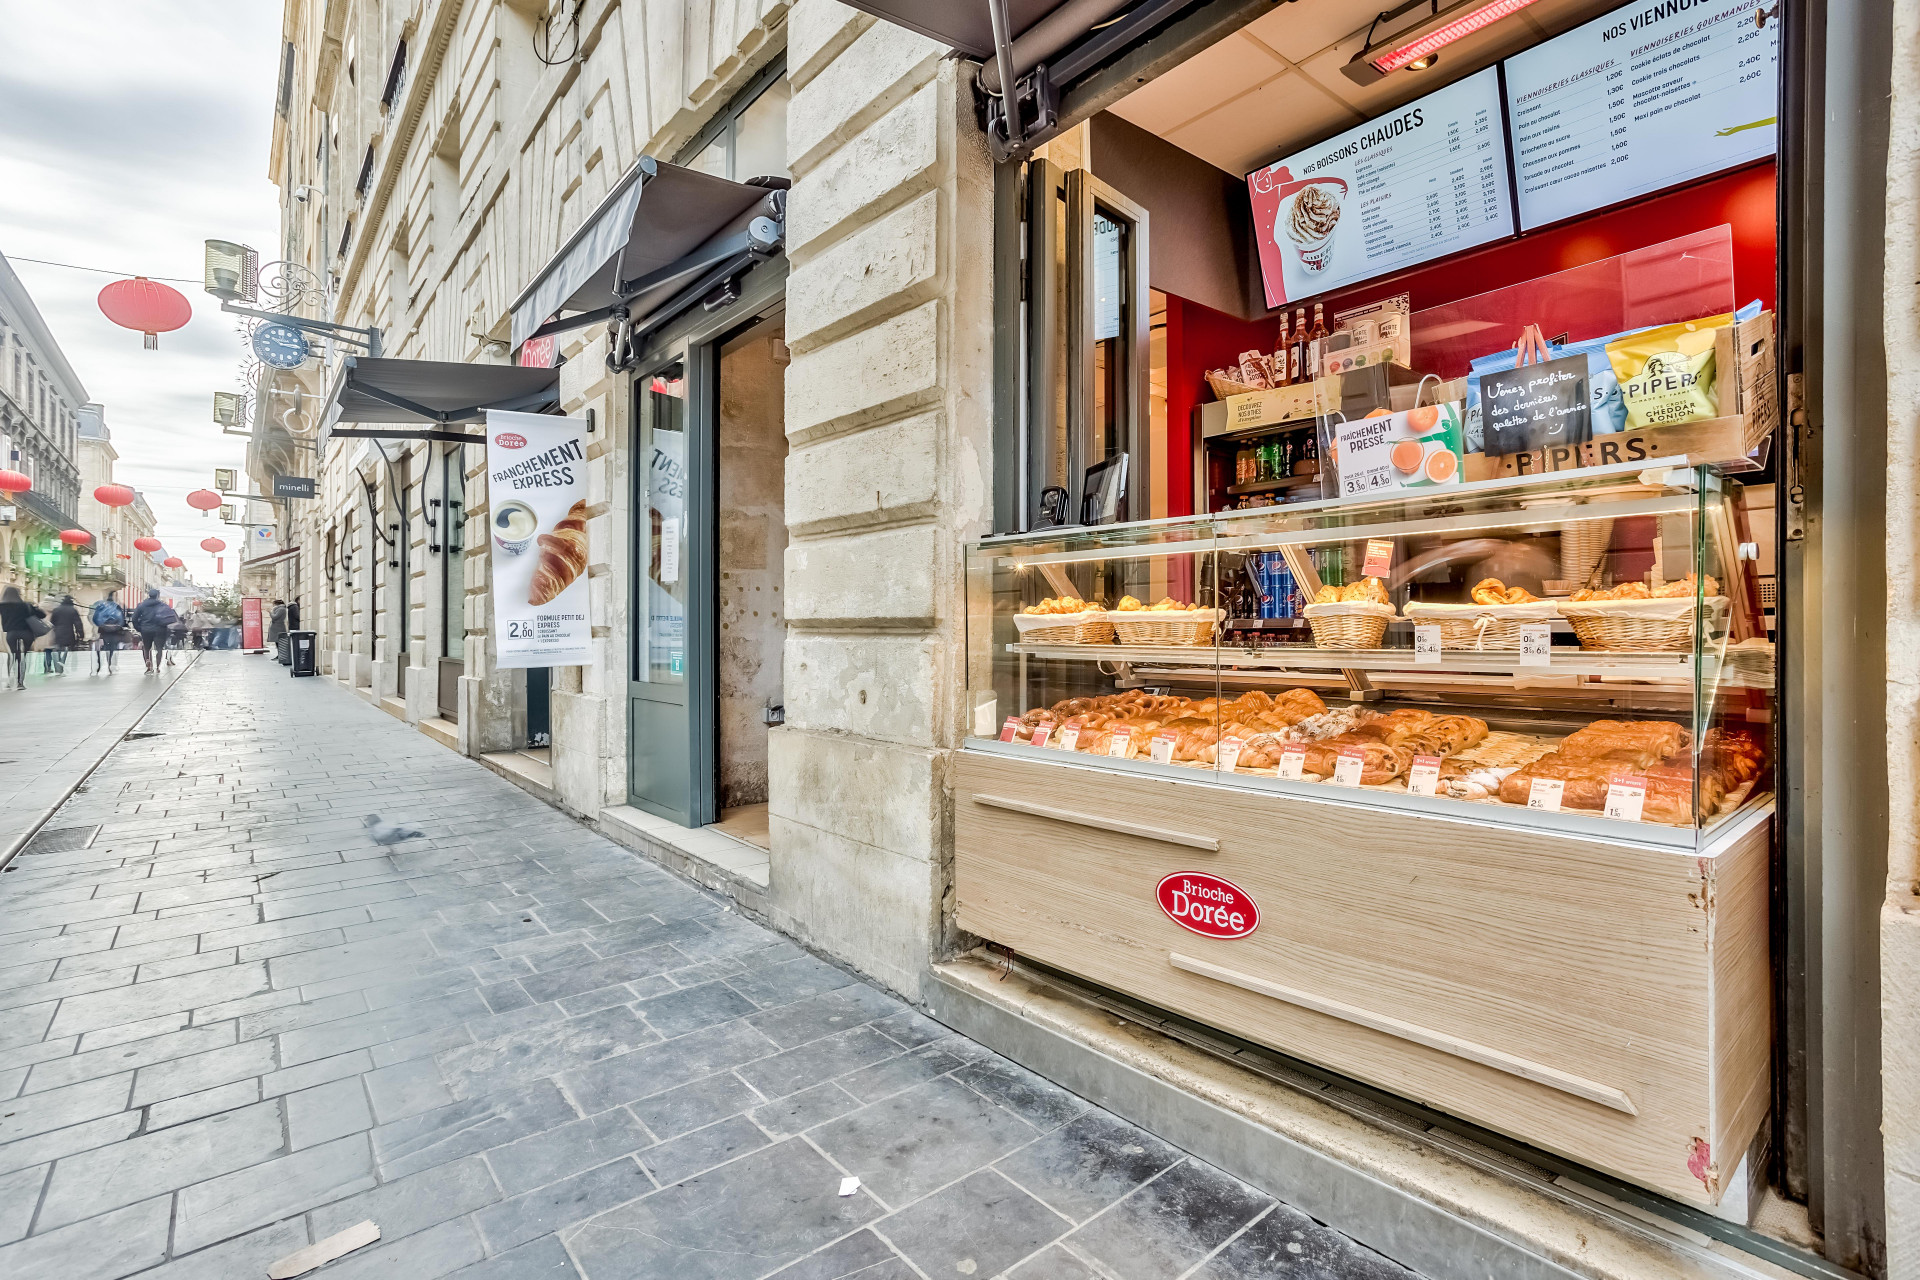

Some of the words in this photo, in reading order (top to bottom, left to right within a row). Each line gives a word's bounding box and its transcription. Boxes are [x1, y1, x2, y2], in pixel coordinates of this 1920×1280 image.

[1602, 22, 1626, 42] NOS
[1630, 25, 1694, 58] VIENNOISERIES
[1738, 30, 1760, 44] 2,20€
[1630, 59, 1651, 72] Cookie
[1673, 45, 1681, 54] de
[1682, 34, 1710, 52] chocolat
[1738, 54, 1761, 68] 2,40€
[1606, 70, 1623, 82] 1,20€
[1632, 73, 1652, 86] Cookie
[1652, 64, 1668, 77] trois
[1669, 54, 1700, 71] chocolats
[1740, 70, 1762, 84] 2,60€
[1516, 78, 1569, 104] VIENNOISERIES
[1570, 58, 1615, 82] CLASSIQUES
[1608, 84, 1624, 96] 1,30€
[1632, 85, 1661, 100] Mascotte
[1662, 76, 1684, 90] saveur
[1608, 98, 1625, 110] 1,50€
[1634, 82, 1691, 108] chocolat-noisettes
[1517, 104, 1542, 117] Croissant
[1538, 109, 1561, 123] chocolat
[1610, 112, 1626, 124] 1,50€
[1634, 110, 1649, 122] Maxi
[1674, 93, 1701, 108] chocolat
[1303, 159, 1316, 175] NOS
[1316, 142, 1358, 168] BOISSONS
[1360, 108, 1424, 150] CHAUDES
[1610, 126, 1627, 138] 1,50€
[1521, 142, 1548, 156] Briochette
[1556, 134, 1571, 144] sucre
[1612, 140, 1628, 152] 1,60€
[1523, 156, 1548, 169] Chausson
[1559, 144, 1581, 158] pommes
[1552, 160, 1574, 172] chocolat
[1611, 154, 1629, 166] 2,00€
[1525, 182, 1549, 194] Croissant
[1581, 162, 1606, 176] noisettes
[1488, 382, 1526, 399] Venez
[1528, 370, 1576, 393] profiter
[1629, 370, 1699, 398] PIPERS
[1491, 405, 1509, 416] des
[1514, 394, 1557, 411] dernières
[1646, 402, 1696, 417] CHEDDAR
[1658, 409, 1694, 421] ONION
[1493, 416, 1528, 431] galettes
[1533, 410, 1546, 420] de
[1548, 402, 1587, 417] l'année
[498, 439, 525, 447] Dorée
[1350, 434, 1384, 453] PRESSE
[492, 438, 583, 482] FRANCHEMENT
[280, 484, 310, 492] minelli
[512, 466, 574, 490] EXPRESS
[1183, 879, 1234, 904] Brioche
[1172, 890, 1244, 932] Dorée
